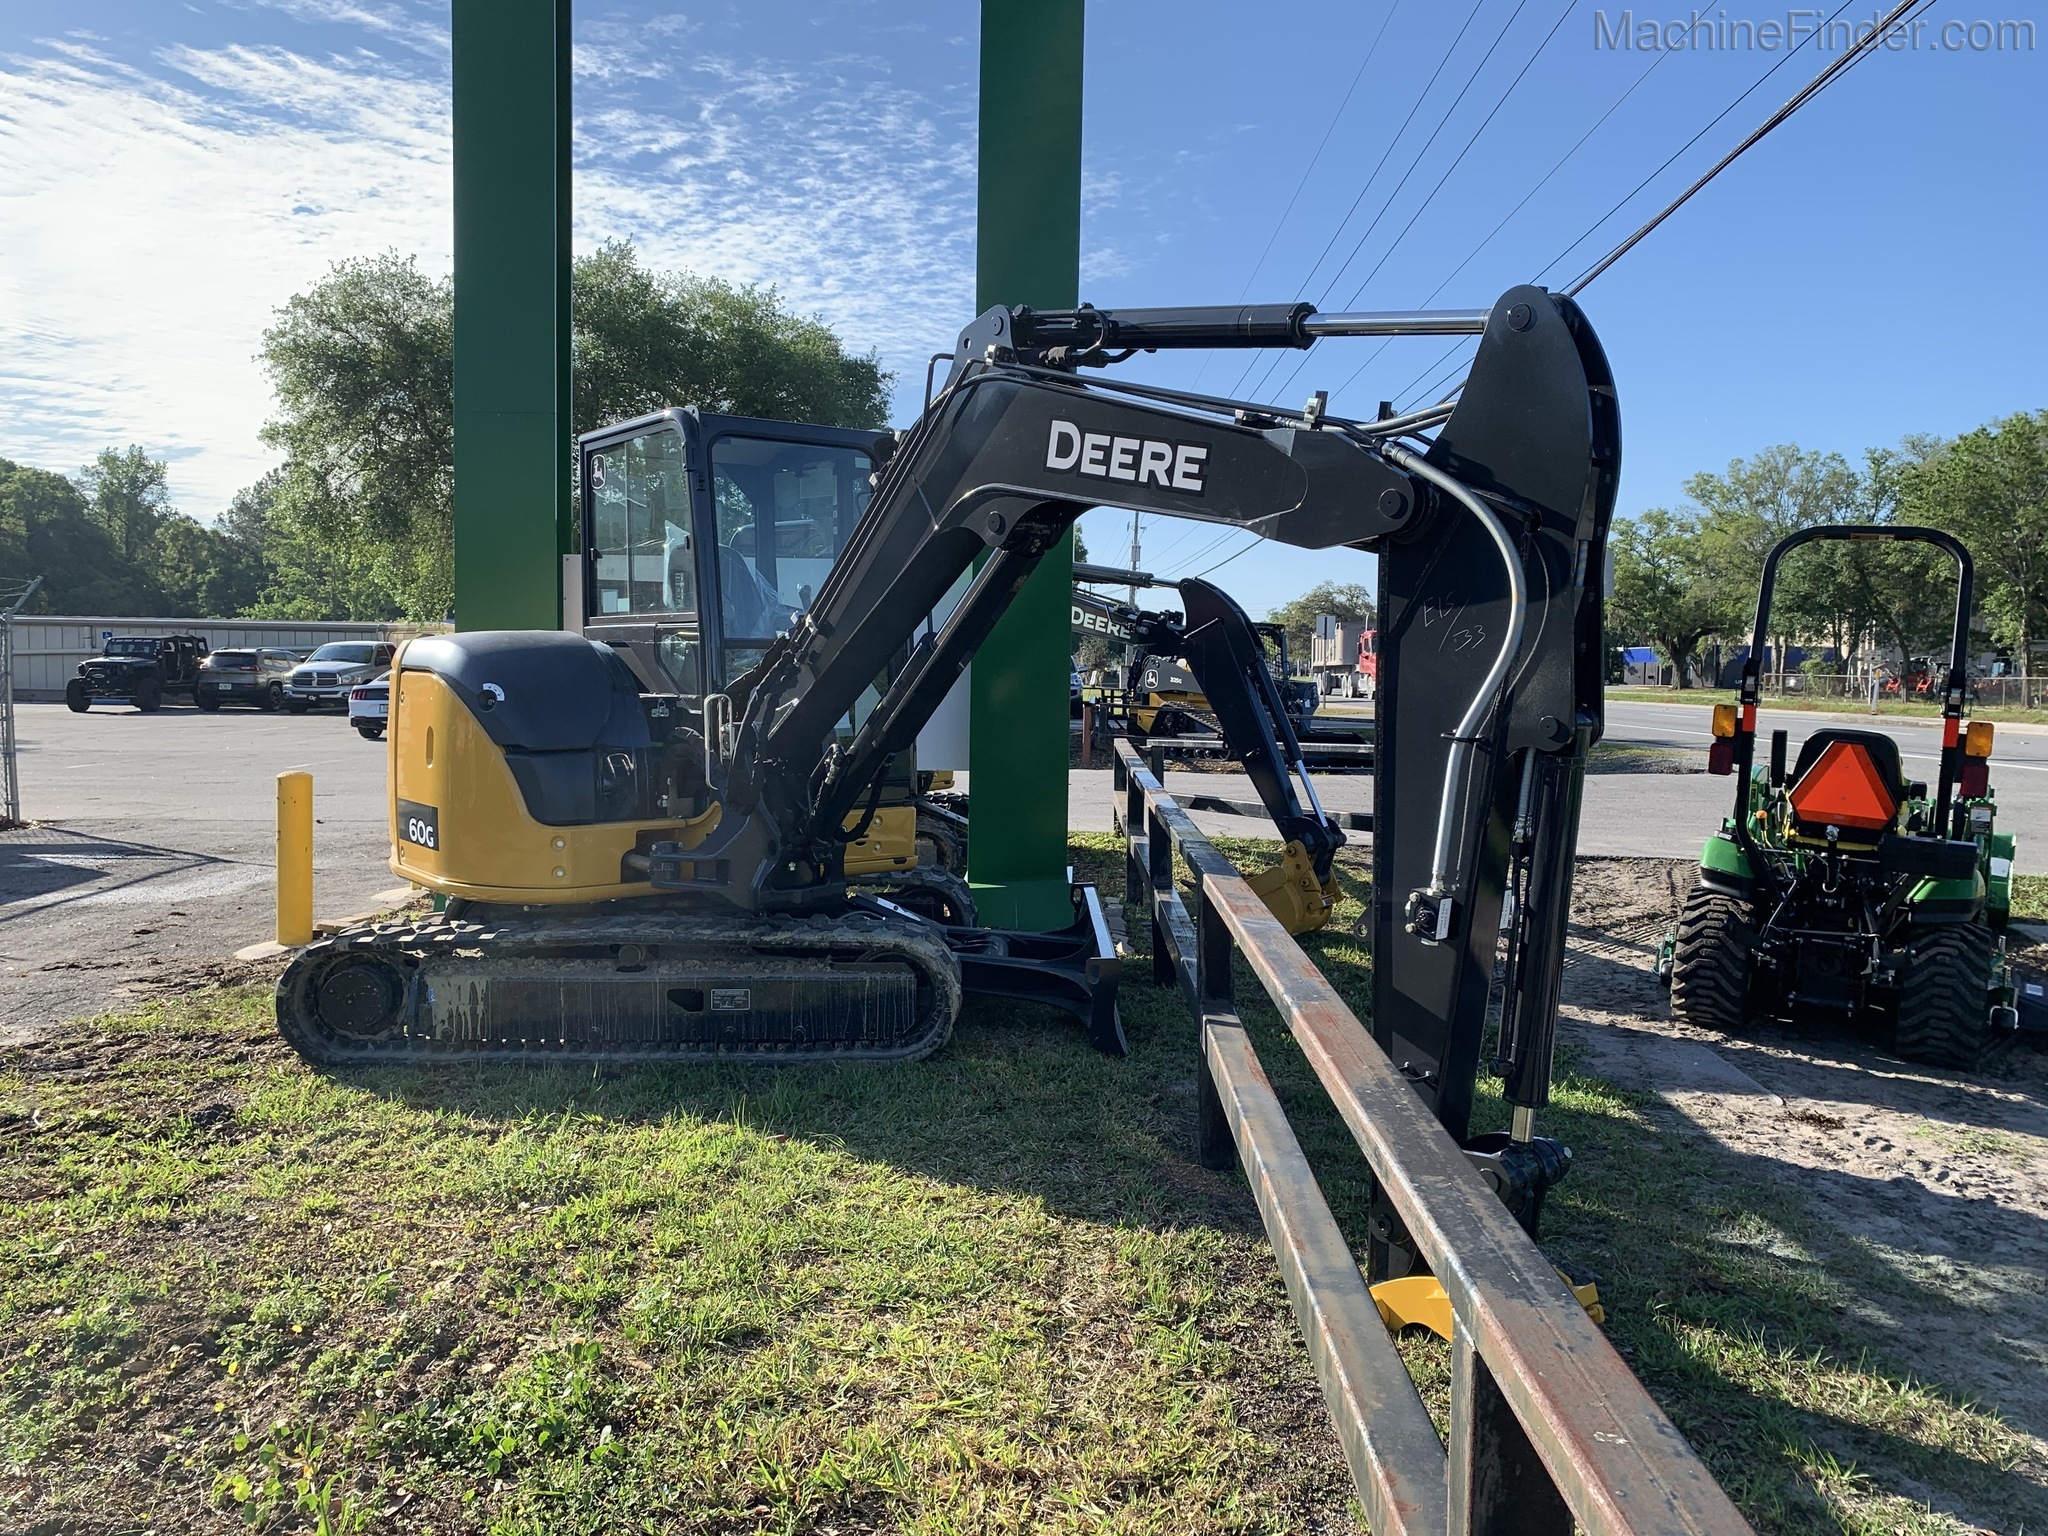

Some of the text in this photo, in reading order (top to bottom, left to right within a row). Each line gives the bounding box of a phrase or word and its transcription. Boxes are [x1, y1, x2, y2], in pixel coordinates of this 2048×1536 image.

[1046, 420, 1208, 491] DEERE
[1071, 605, 1131, 639] DEERE
[409, 817, 434, 847] 60G
